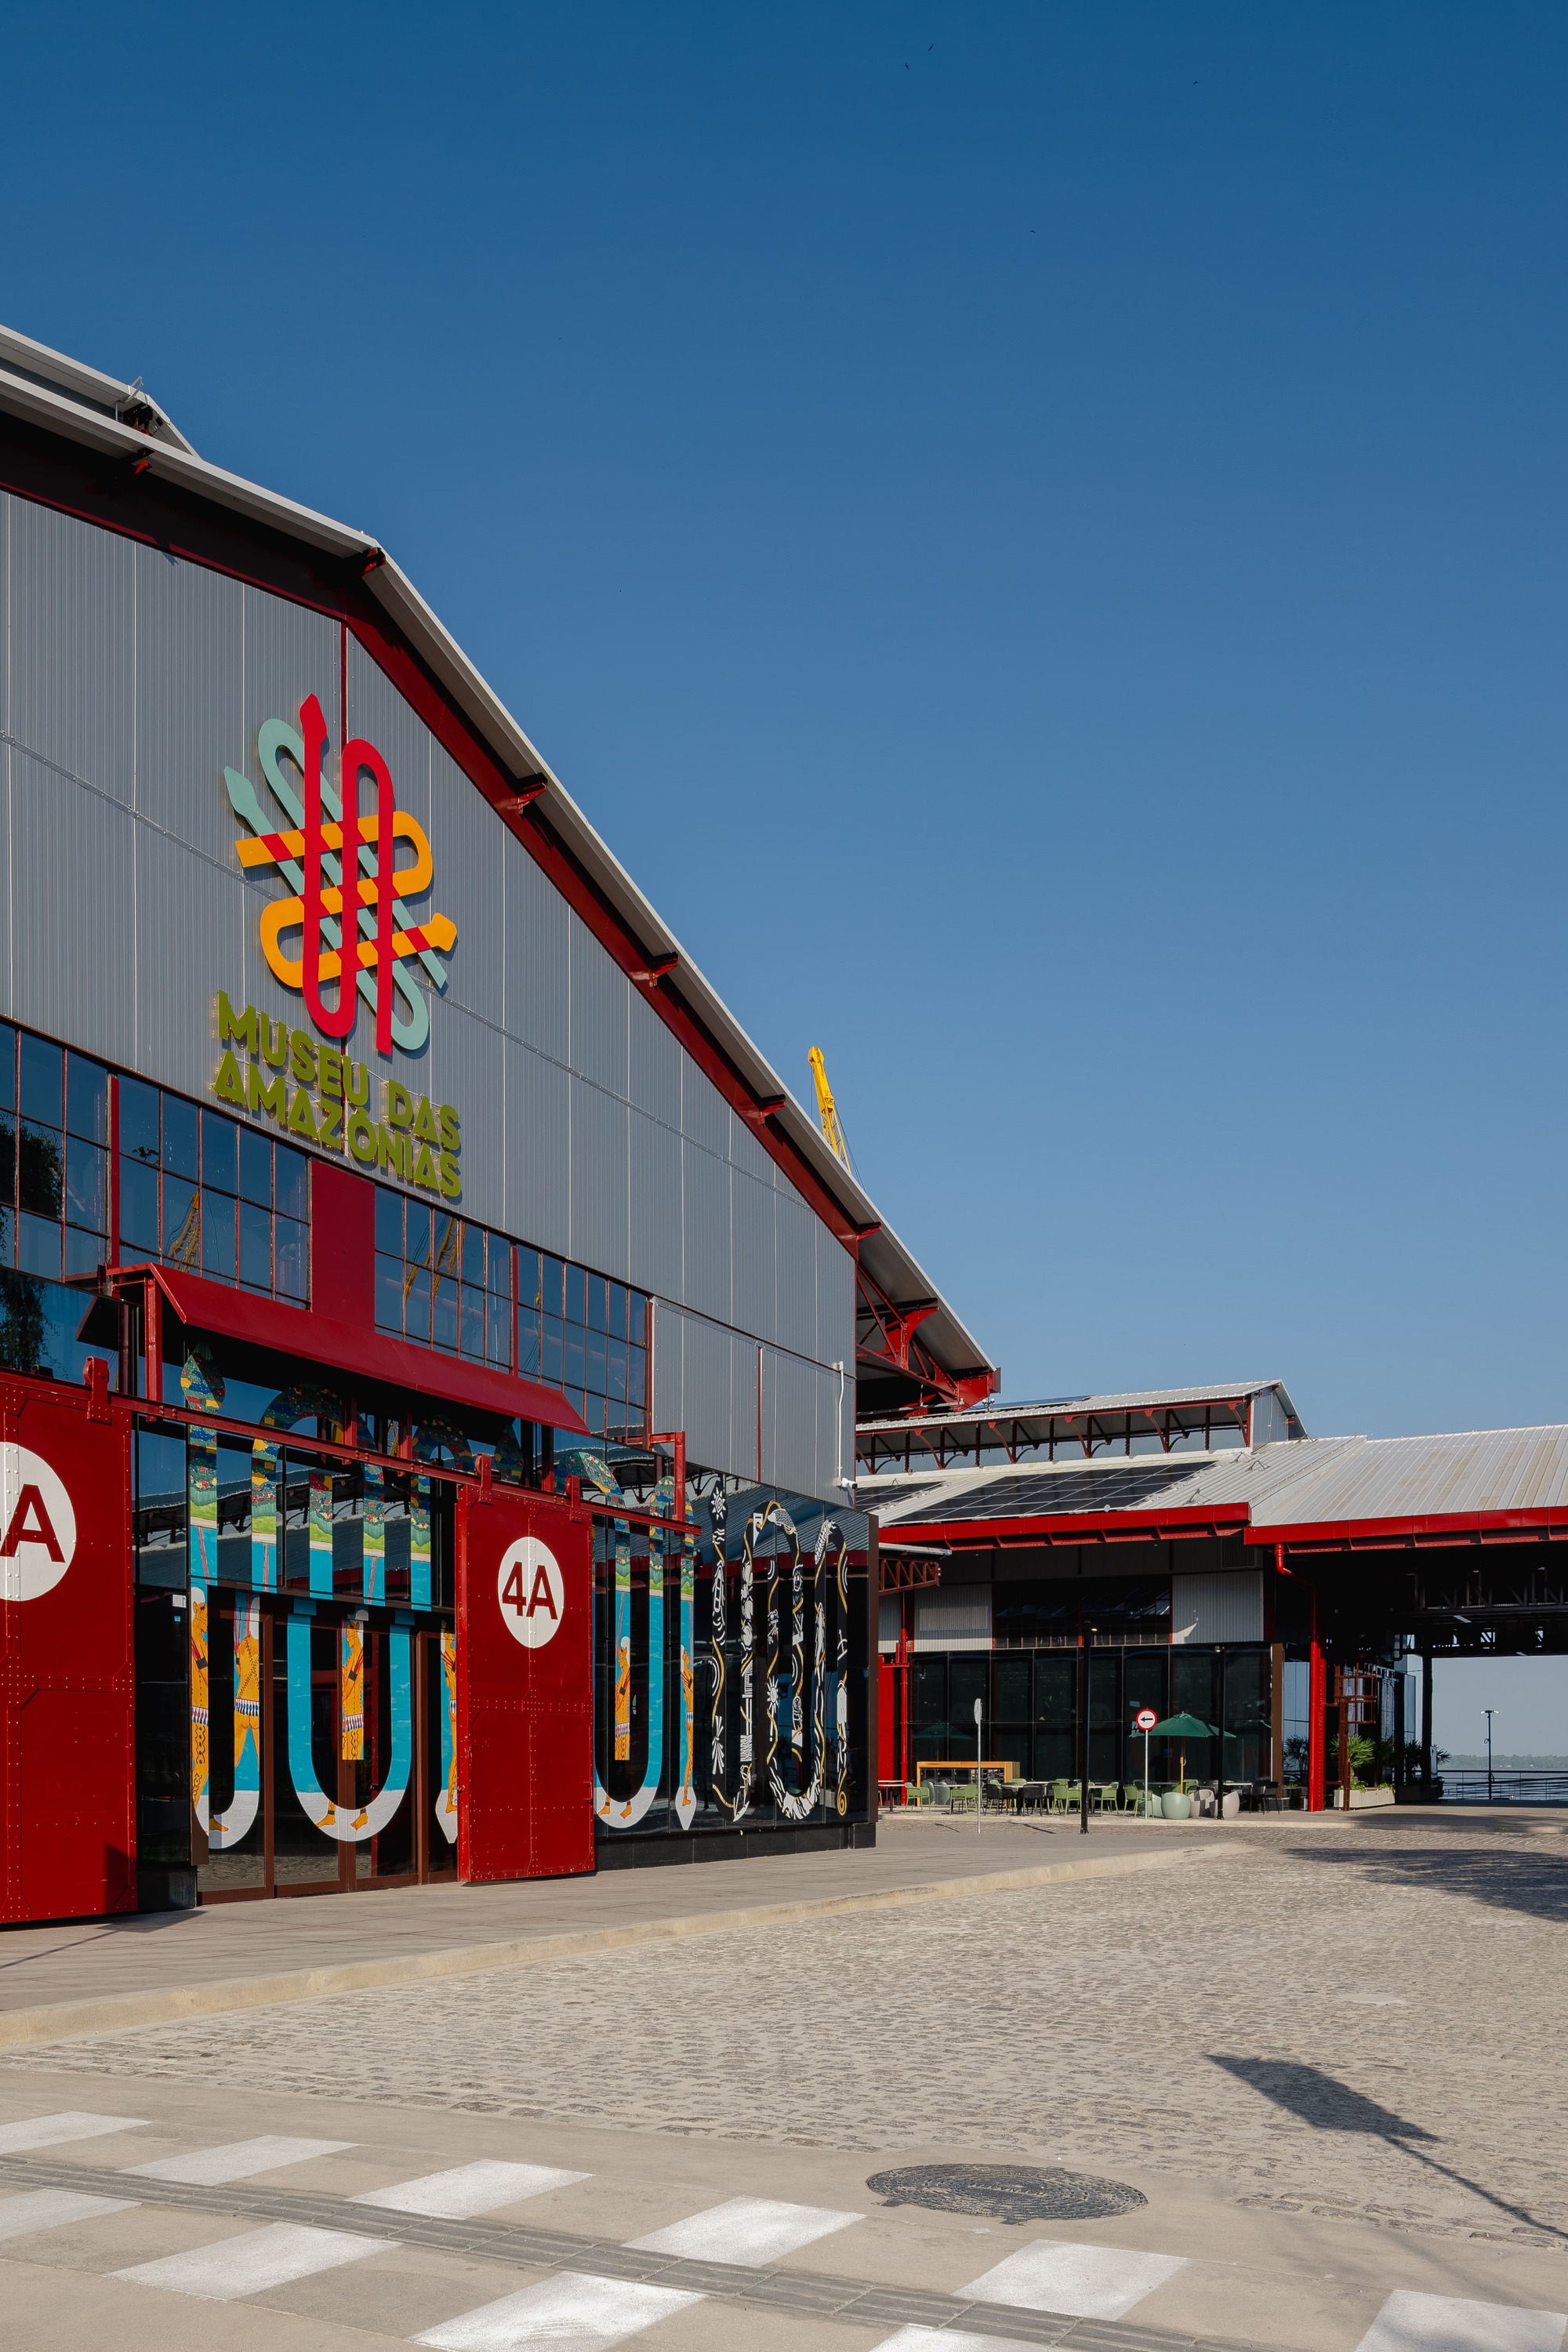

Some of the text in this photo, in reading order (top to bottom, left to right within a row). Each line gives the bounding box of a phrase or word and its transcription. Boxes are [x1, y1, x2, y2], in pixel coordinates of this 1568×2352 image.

[217, 989, 460, 1151] MUSEU DAS
[0, 1484, 66, 1563] A
[502, 1561, 558, 1621] 4A
